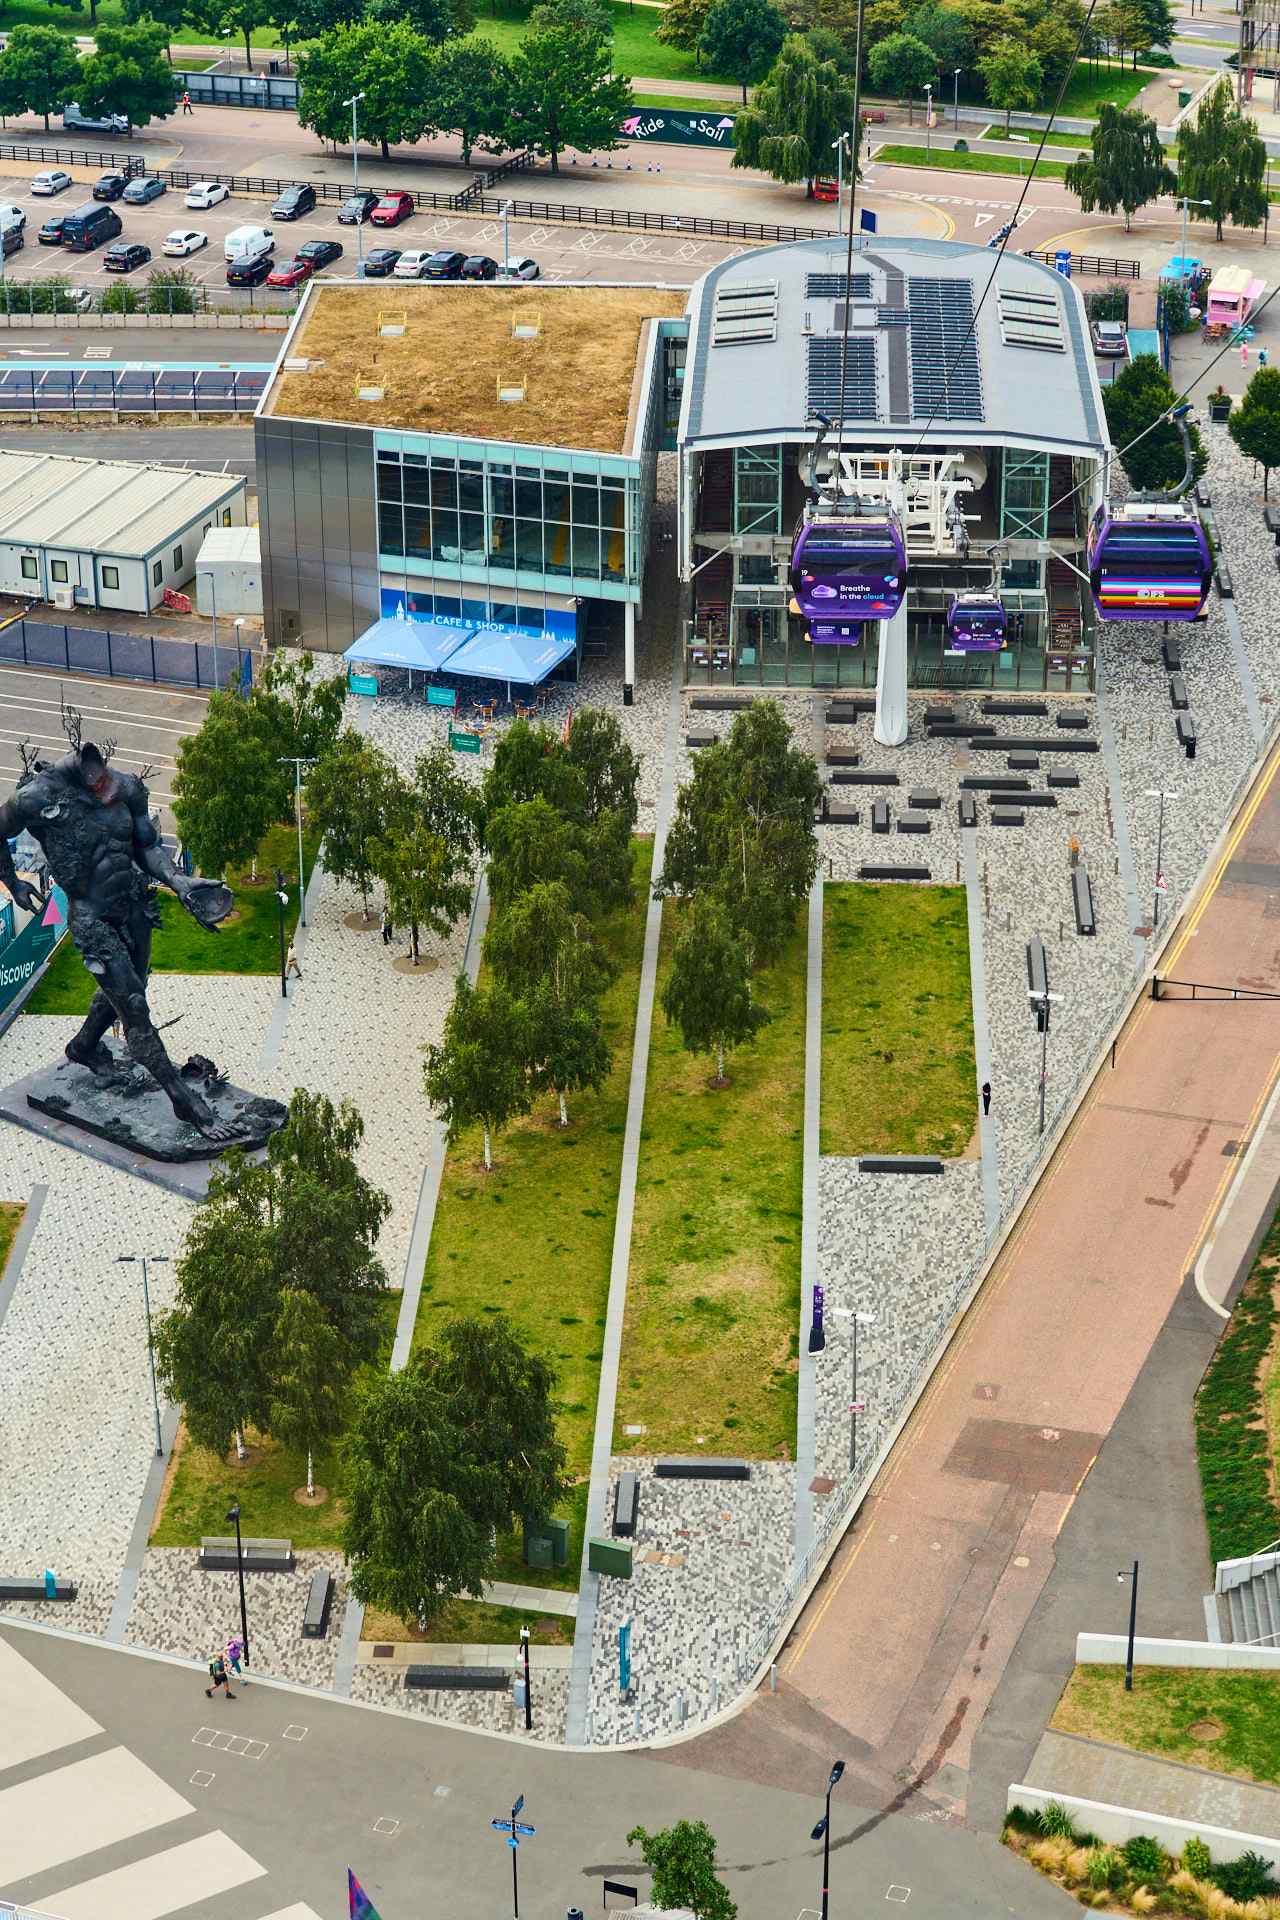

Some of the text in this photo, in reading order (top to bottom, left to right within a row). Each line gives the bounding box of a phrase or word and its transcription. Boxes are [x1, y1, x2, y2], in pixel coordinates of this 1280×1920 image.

[633, 118, 665, 139] Ride
[697, 119, 725, 142] Sail
[435, 615, 505, 632] CAFE & SHOP
[0, 960, 35, 987] iscover
